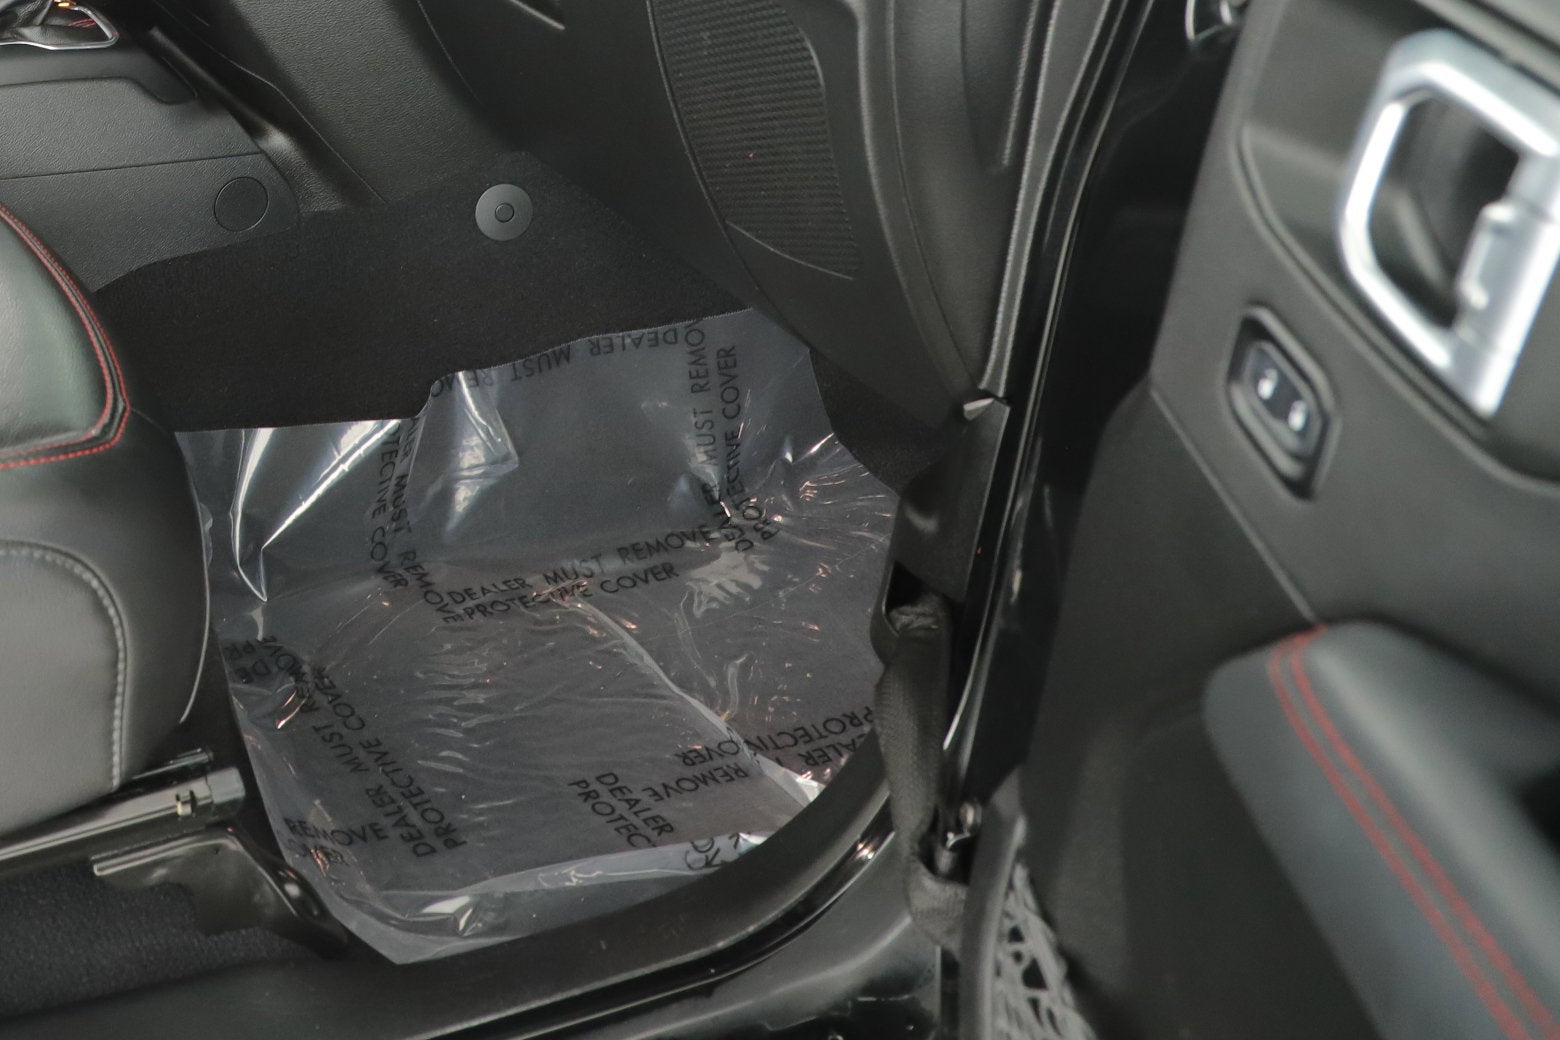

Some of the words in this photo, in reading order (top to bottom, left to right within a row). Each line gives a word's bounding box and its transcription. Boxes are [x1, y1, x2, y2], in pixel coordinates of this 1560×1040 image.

[589, 328, 678, 357] DEALER
[717, 345, 741, 420] COVER
[370, 526, 409, 588] COVER
[399, 549, 465, 624] REMOVE
[447, 577, 534, 605] DEALER
[542, 553, 605, 586] MUST
[616, 524, 717, 565] REMOVE
[599, 561, 680, 594] COVER
[312, 723, 370, 773] MUST
[797, 732, 868, 768] ALER
[359, 737, 468, 850] PROTECTIVE
[594, 771, 675, 837] DEALER
[641, 762, 750, 802] REMOVE
[365, 784, 438, 858] DEALER
